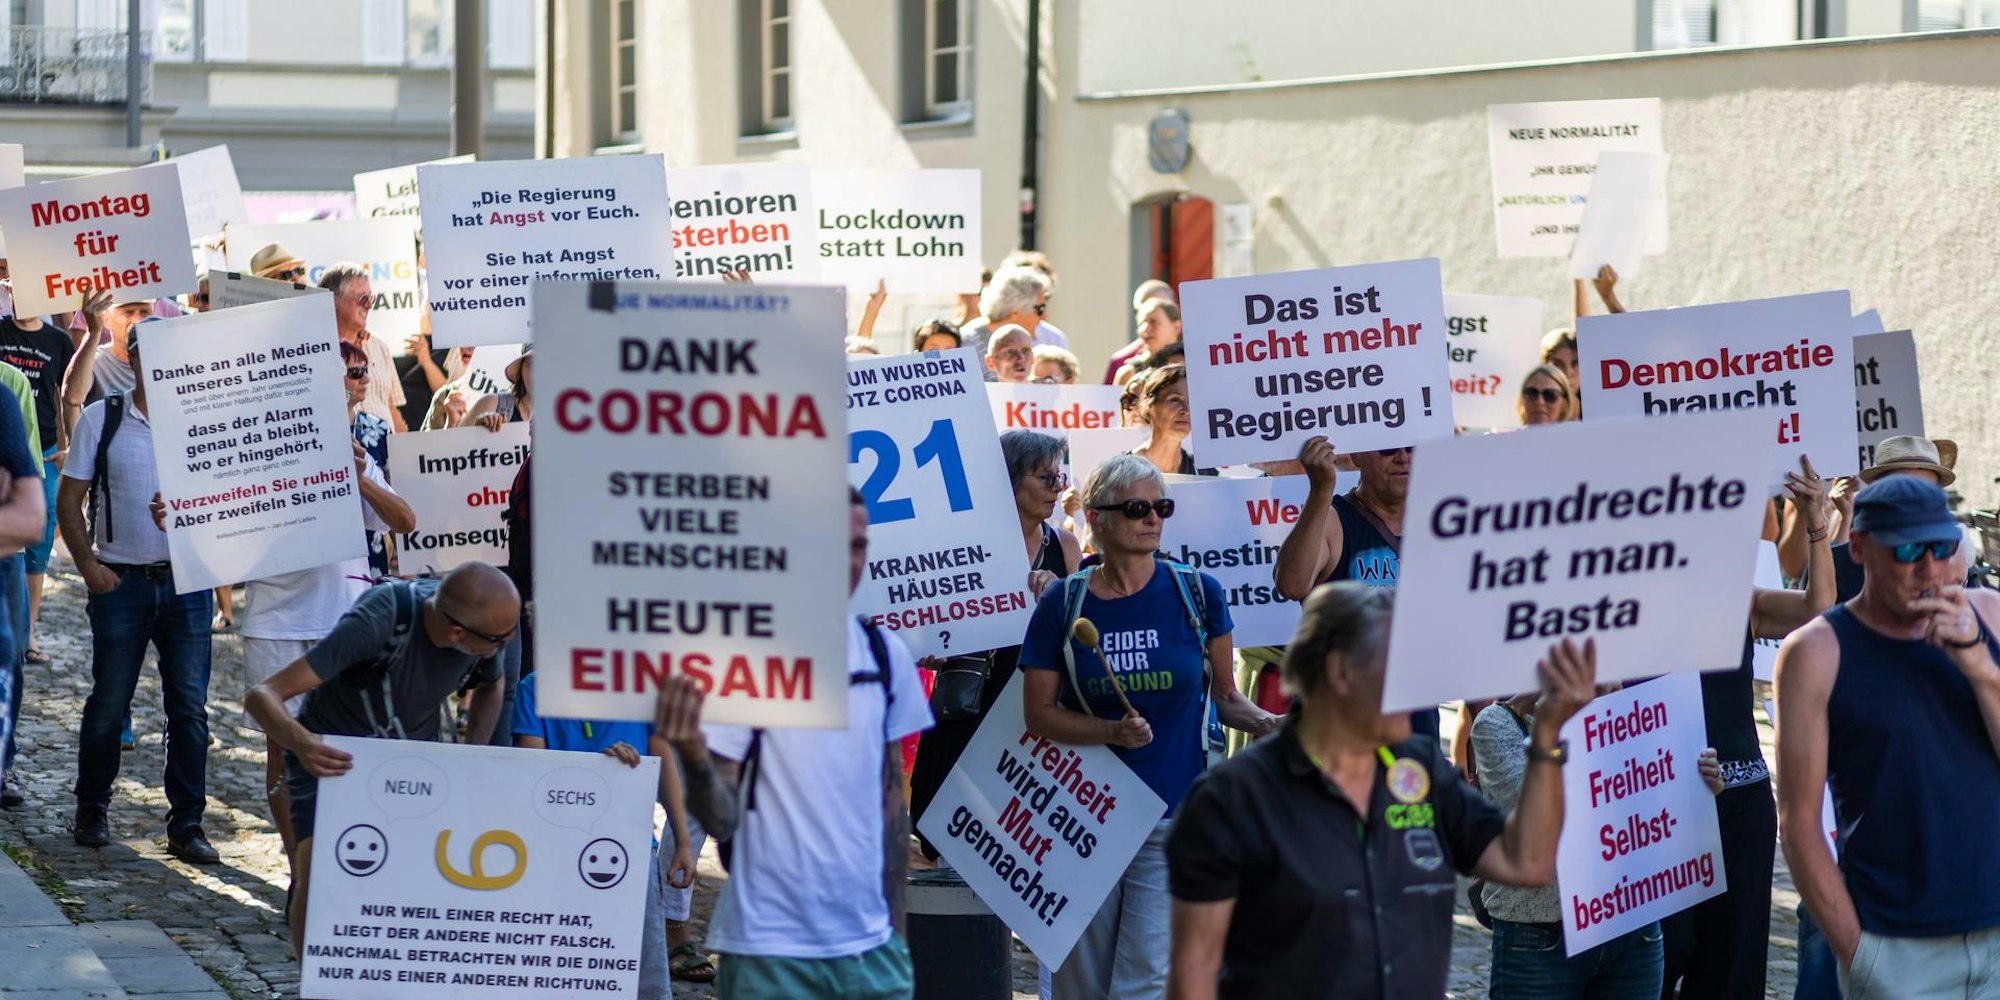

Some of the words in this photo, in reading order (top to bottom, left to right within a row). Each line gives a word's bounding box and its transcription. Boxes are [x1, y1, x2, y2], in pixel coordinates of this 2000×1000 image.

[1509, 128, 1546, 140] NEUE
[1550, 122, 1639, 139] NORMALITÄT
[31, 193, 150, 227] Montag
[472, 190, 512, 208] „Die
[519, 187, 616, 204] Regierung
[452, 212, 483, 227] hat
[489, 209, 545, 227] Angst
[551, 209, 579, 222] vor
[587, 205, 639, 220] Euch.
[819, 209, 965, 230] Lockdown
[74, 232, 119, 257] für
[672, 220, 789, 248] sterben
[819, 236, 885, 257] statt
[896, 236, 964, 257] Lohn
[486, 252, 516, 266] Sie
[523, 250, 553, 265] hat
[559, 247, 615, 264] Angst
[45, 260, 162, 298] Freiheit
[443, 277, 474, 290] vor
[480, 272, 529, 288] einer
[431, 294, 526, 312] wütenden
[1244, 293, 1319, 326] Das
[1333, 286, 1381, 316] ist
[1208, 328, 1309, 366] nicht
[1323, 318, 1422, 354] mehr
[1445, 316, 1487, 336] gst
[152, 362, 205, 382] Danke
[211, 359, 230, 371] an
[236, 352, 266, 368] alle
[271, 342, 331, 362] Medien
[618, 337, 759, 375] DANK
[881, 358, 966, 382] WURDEN
[1600, 338, 1834, 390] Demokratie
[176, 374, 242, 395] unseres
[248, 363, 313, 383] Landes,
[208, 393, 225, 401] über
[227, 389, 249, 398] einem
[251, 385, 266, 394] Jahr
[268, 378, 312, 390] unermüdlich
[884, 379, 966, 404] CORONA
[1254, 362, 1384, 399] unsere
[1450, 374, 1502, 395] eit?
[184, 406, 197, 414] und
[200, 404, 210, 412] mit
[212, 400, 232, 409] klarer
[234, 395, 262, 406] Haltung
[264, 392, 282, 400] dafür
[555, 387, 827, 439] CORONA
[1207, 397, 1405, 442] Regierung
[1421, 386, 1432, 417] !
[1643, 379, 1796, 418] braucht
[188, 422, 226, 438] dass
[232, 416, 259, 429] der
[264, 406, 313, 423] Alarm
[1006, 402, 1115, 429] Kinder
[186, 438, 237, 458] genau
[242, 432, 262, 444] da
[268, 422, 320, 440] bleibt,
[187, 460, 212, 472] wo
[218, 455, 234, 467] er
[238, 438, 323, 463] hingehört,
[243, 466, 260, 476] ganz
[262, 462, 279, 472] ganz
[848, 418, 974, 526] 21
[170, 484, 267, 512] Verzweifeln
[272, 472, 298, 492] Sie
[302, 466, 350, 488] ruhig!
[608, 472, 770, 501] STERBEN
[174, 508, 212, 528] Aber
[218, 496, 286, 521] zweifeln
[291, 490, 317, 506] Sie
[322, 483, 351, 500] nie!
[639, 507, 740, 535] VIELE
[1429, 472, 1745, 539] Grundrechte
[592, 541, 787, 572] MENSCHEN
[869, 545, 992, 580] KRANKEN-
[1469, 546, 1550, 591] hat
[1568, 539, 1689, 580] man.
[887, 572, 985, 604] HÄUSER
[607, 598, 775, 637] HEUTE
[871, 591, 1027, 631] ESCHLOSSEN
[1504, 596, 1640, 642] Basta
[939, 631, 951, 649] ?
[570, 648, 814, 700] EINSAM
[1105, 651, 1149, 672] NUR
[1087, 671, 1173, 694] GESUND
[1584, 699, 1667, 753] Frieden
[385, 779, 433, 797] NEUN
[1589, 748, 1675, 808] Freiheit
[547, 789, 596, 806] SECHS
[995, 748, 1058, 815] wird
[1048, 805, 1097, 859] aus
[997, 795, 1054, 866] Mut
[1600, 807, 1677, 862] Selbst-
[947, 805, 1068, 927] gemacht!
[1573, 852, 1715, 931] bestimmung
[361, 904, 396, 917] NUR
[401, 906, 441, 920] WEIL
[446, 908, 495, 923] EINER
[500, 911, 554, 925] RECHT
[559, 913, 593, 930] HAT,
[333, 924, 382, 938] LIEGT
[387, 927, 419, 941] DER
[424, 929, 490, 943] ANDERE
[496, 932, 544, 946] NICHT
[550, 934, 616, 949] FALSCH.
[307, 945, 402, 960] MANCHMAL
[407, 949, 516, 966] BETRACHTEN
[521, 954, 552, 968] WIR
[558, 956, 583, 969] DIE
[588, 958, 637, 972] DINGE
[319, 967, 354, 980] NUR
[359, 969, 392, 981] AUS
[397, 970, 446, 984] EINER
[451, 973, 529, 988] ANDEREN
[534, 976, 622, 992] RICHTUNG.
